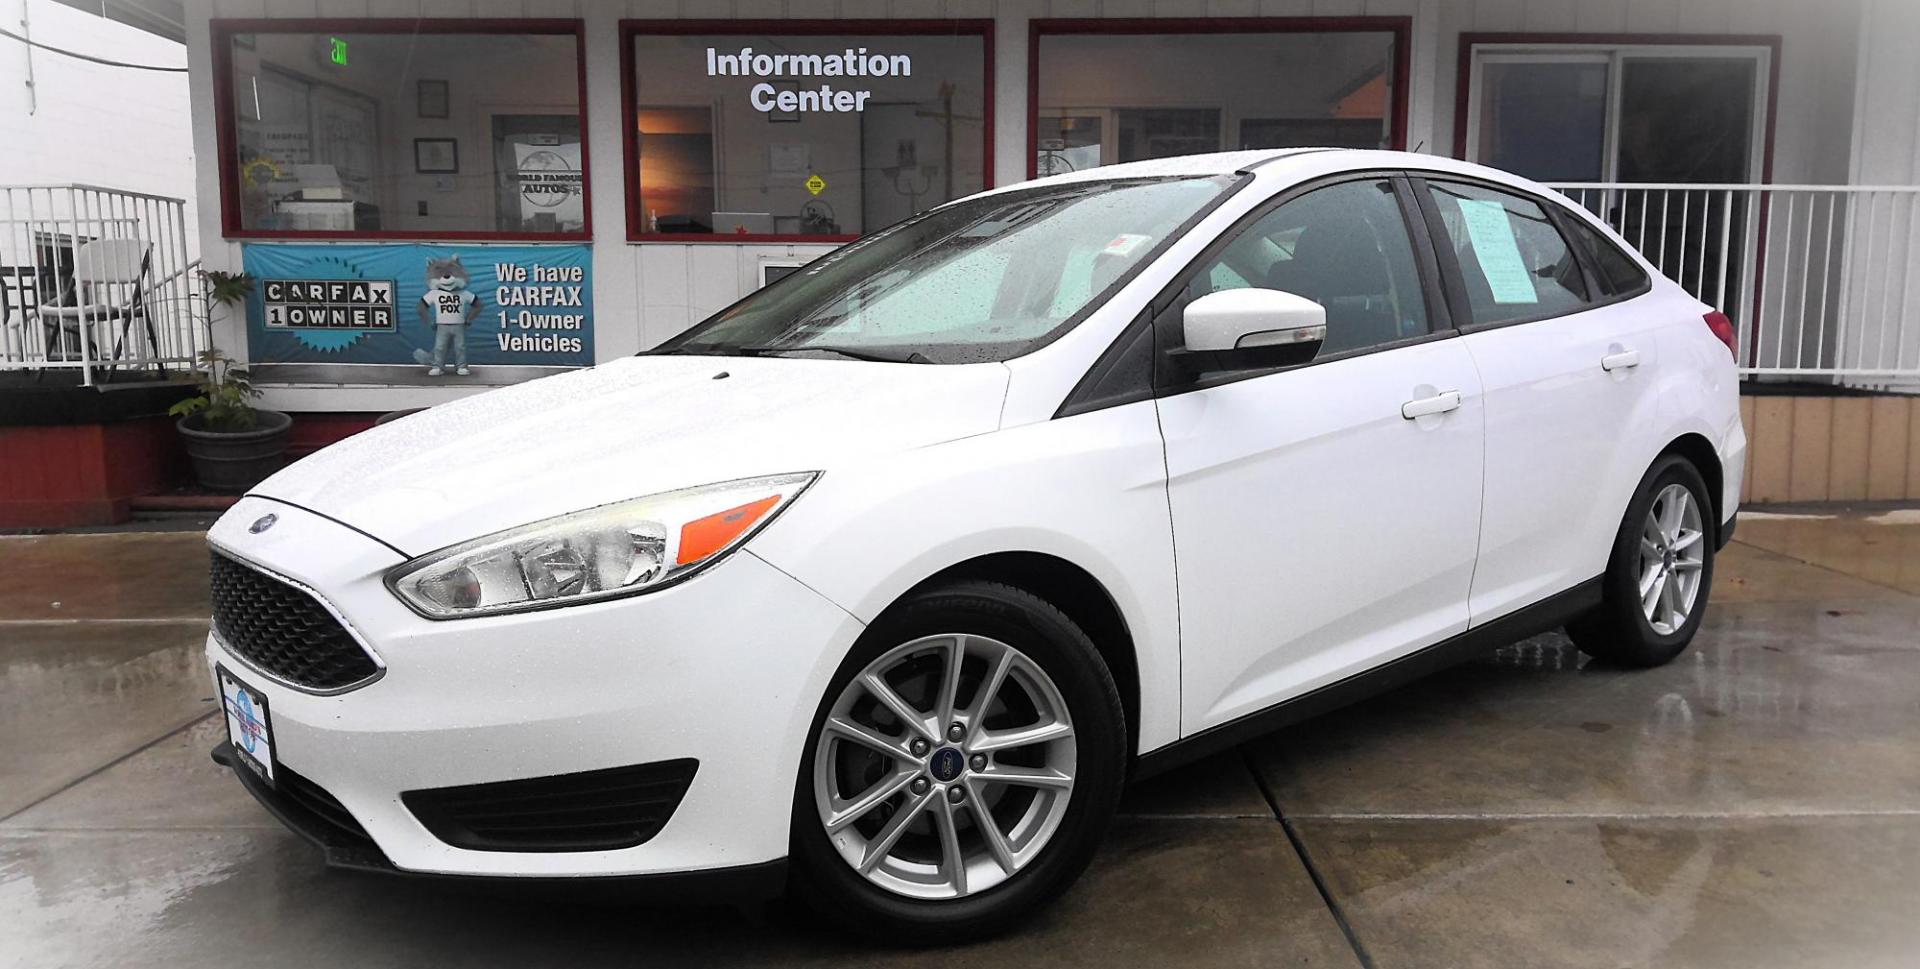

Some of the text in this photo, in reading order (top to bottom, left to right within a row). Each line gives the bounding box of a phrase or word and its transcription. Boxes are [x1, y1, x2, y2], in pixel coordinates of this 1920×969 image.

[706, 47, 911, 77] Information
[750, 82, 871, 112] Center
[523, 184, 569, 194] AUTOS
[495, 263, 583, 282] We have
[267, 283, 388, 304] CARFAX
[438, 295, 461, 304] CAR
[496, 285, 583, 306] CARFAX
[270, 307, 388, 325] 1 OWNER
[440, 304, 461, 314] FOX
[497, 310, 584, 330] 1-Owner
[497, 333, 582, 353] Vehicles
